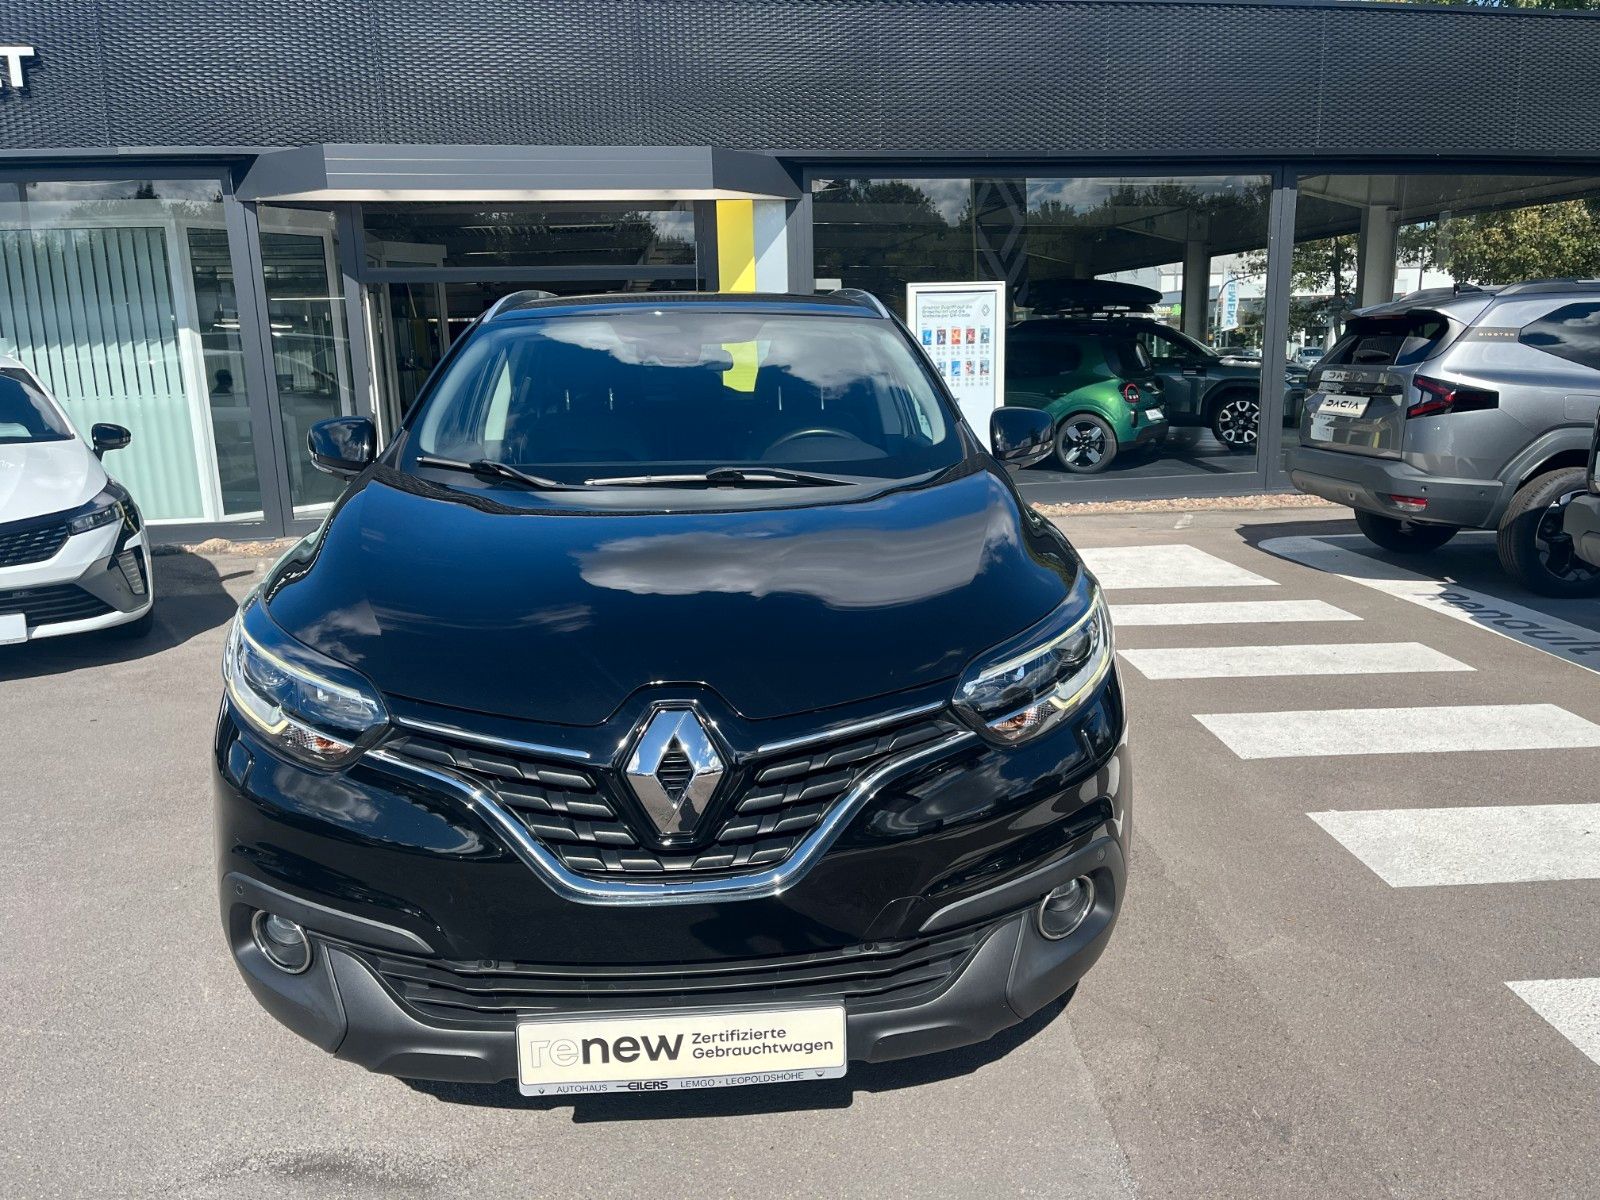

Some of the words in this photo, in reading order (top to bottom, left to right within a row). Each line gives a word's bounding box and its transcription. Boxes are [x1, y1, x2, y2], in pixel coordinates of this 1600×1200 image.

[0, 46, 35, 87] T
[1326, 399, 1359, 409] DACIA
[692, 1028, 787, 1044] Zertifizierte
[530, 1034, 684, 1068] renew
[692, 1040, 834, 1059] Gebrauchtwagen
[556, 1084, 608, 1093] AUTOHAUS
[617, 1081, 668, 1091] EILERS
[680, 1079, 715, 1088] LEMGO
